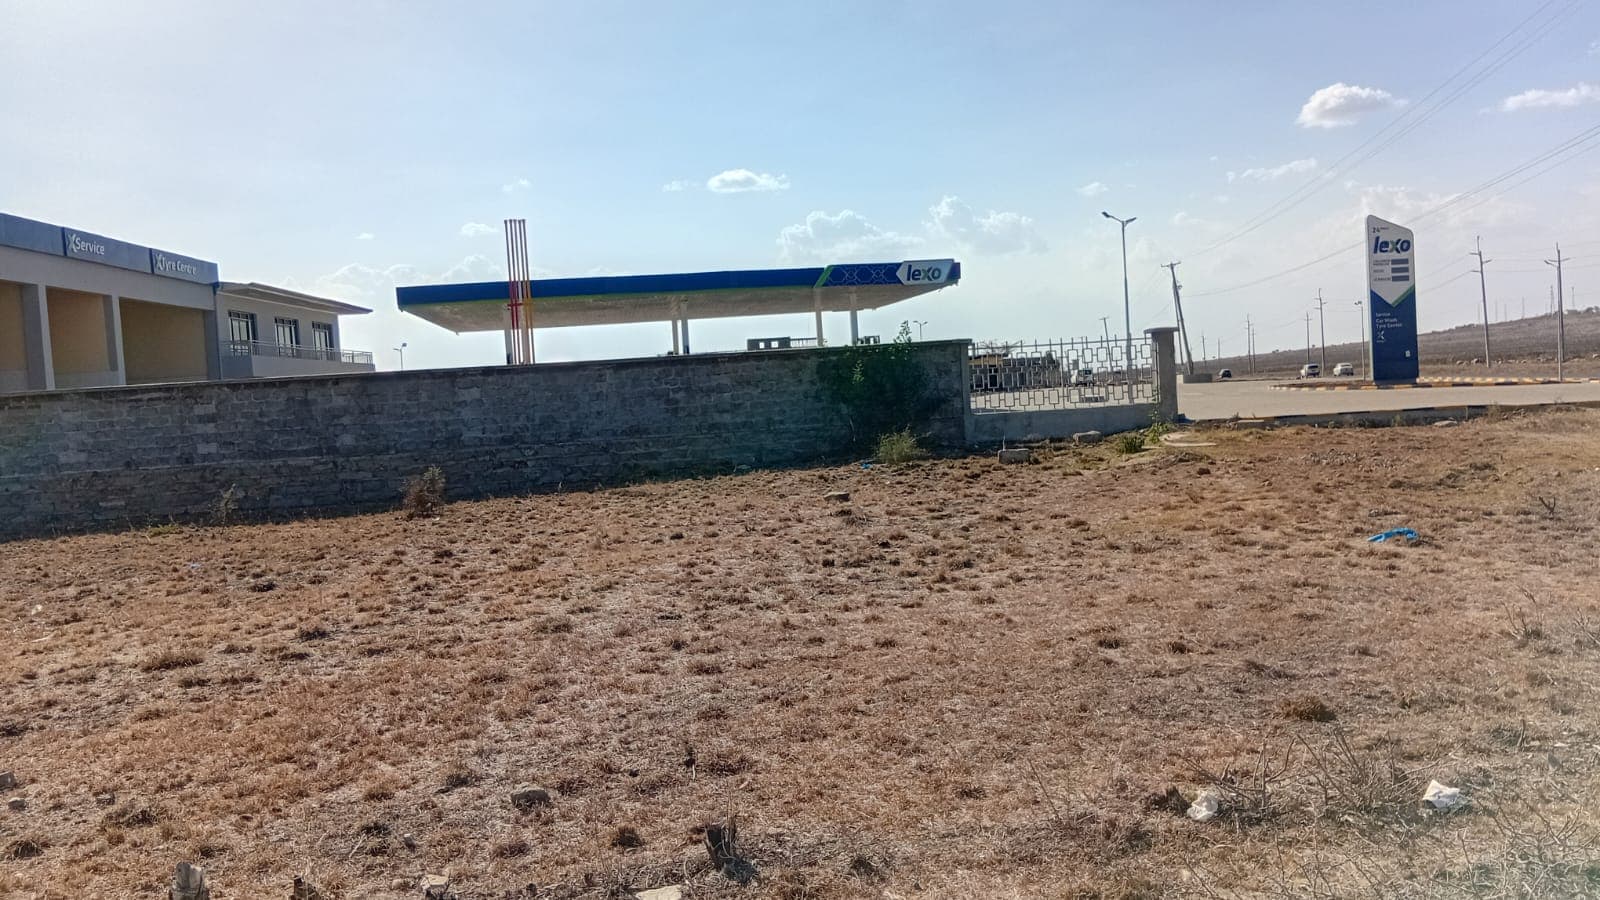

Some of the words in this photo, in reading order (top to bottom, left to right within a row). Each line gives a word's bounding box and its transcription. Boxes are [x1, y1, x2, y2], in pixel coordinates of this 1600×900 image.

[76, 238, 105, 255] Service
[1373, 236, 1411, 254] lexo
[906, 264, 942, 281] lexo
